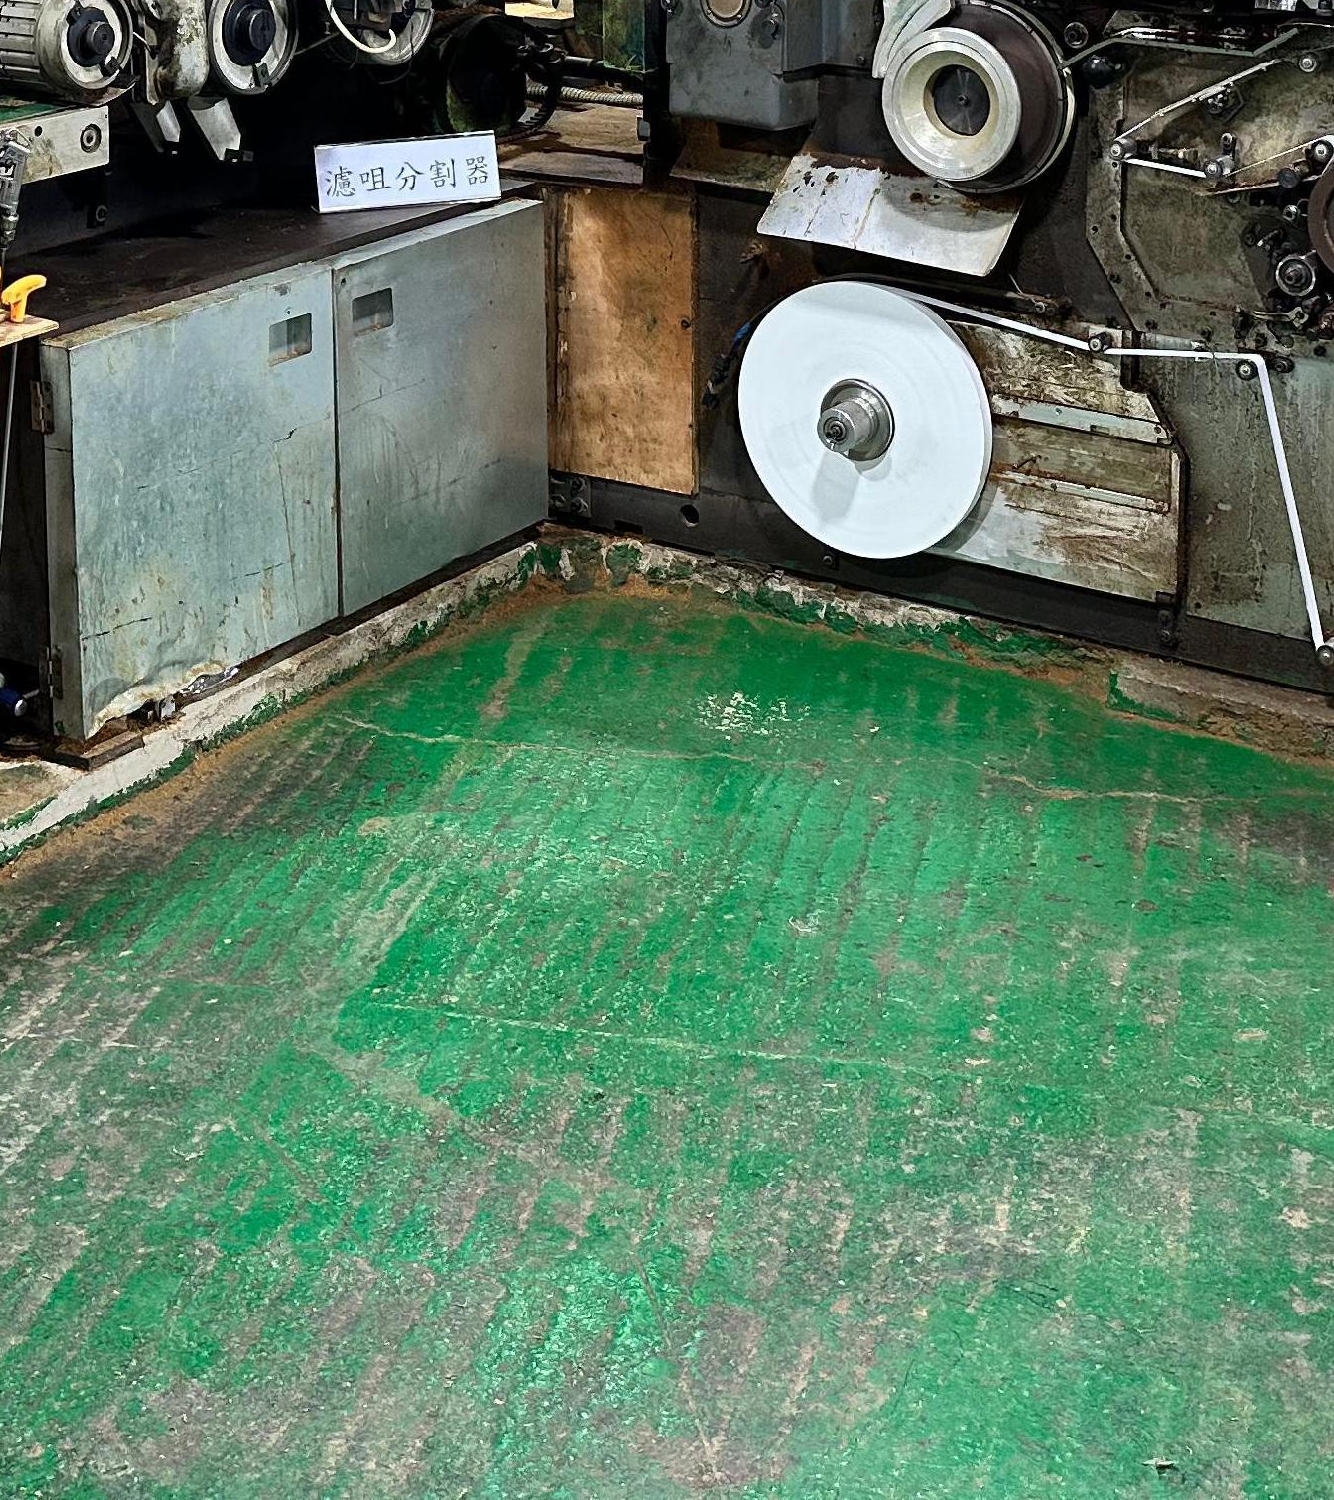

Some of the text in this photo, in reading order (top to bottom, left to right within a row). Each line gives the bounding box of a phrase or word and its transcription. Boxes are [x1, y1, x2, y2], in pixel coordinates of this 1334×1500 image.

[325, 156, 488, 198] 濾咀分割器
